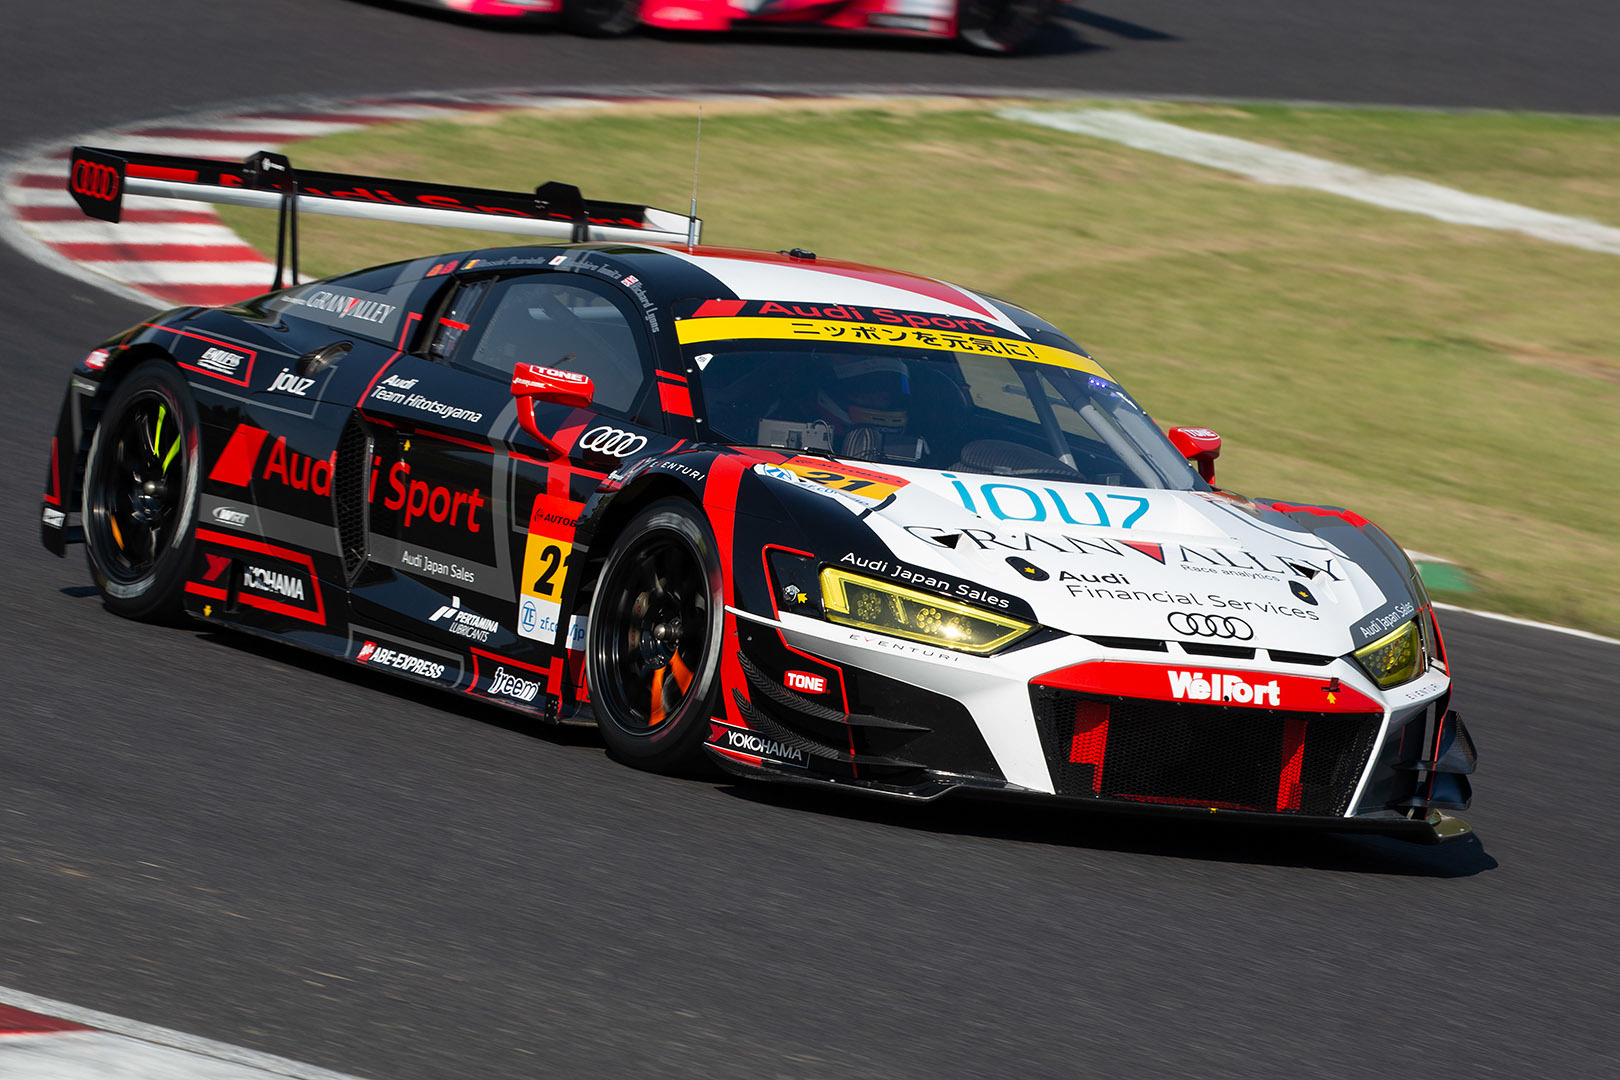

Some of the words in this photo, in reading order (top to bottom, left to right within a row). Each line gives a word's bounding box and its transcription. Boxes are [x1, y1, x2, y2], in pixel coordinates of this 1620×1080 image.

[758, 301, 865, 320] Audi
[872, 309, 996, 334] Sport
[381, 374, 419, 390] Audi
[536, 366, 583, 382] TONE
[370, 386, 406, 404] Team
[404, 393, 483, 423] Hitotsuyama
[807, 471, 876, 492] 21
[384, 461, 484, 533] Sport
[401, 550, 422, 567] Audi
[423, 557, 449, 576] Japan
[450, 565, 475, 583] Sales
[840, 552, 888, 572] Audi
[891, 566, 950, 591] Japan
[956, 584, 1010, 608] Sales
[1058, 570, 1130, 585] Audi
[1180, 564, 1218, 574] Race
[1221, 567, 1281, 582] analytics
[1066, 584, 1203, 606] Financial
[1207, 594, 1320, 621] Services
[448, 622, 490, 642] LUBRICANTS
[454, 611, 499, 633] PERTAMINA
[1360, 620, 1381, 638] Audi
[1376, 613, 1401, 631] Japan
[849, 633, 959, 662] EVENTURI
[370, 646, 445, 680] ABE-EXPRESS
[487, 666, 539, 701] freem
[787, 672, 824, 691] TONE
[727, 731, 803, 762] YOKOHAMA
